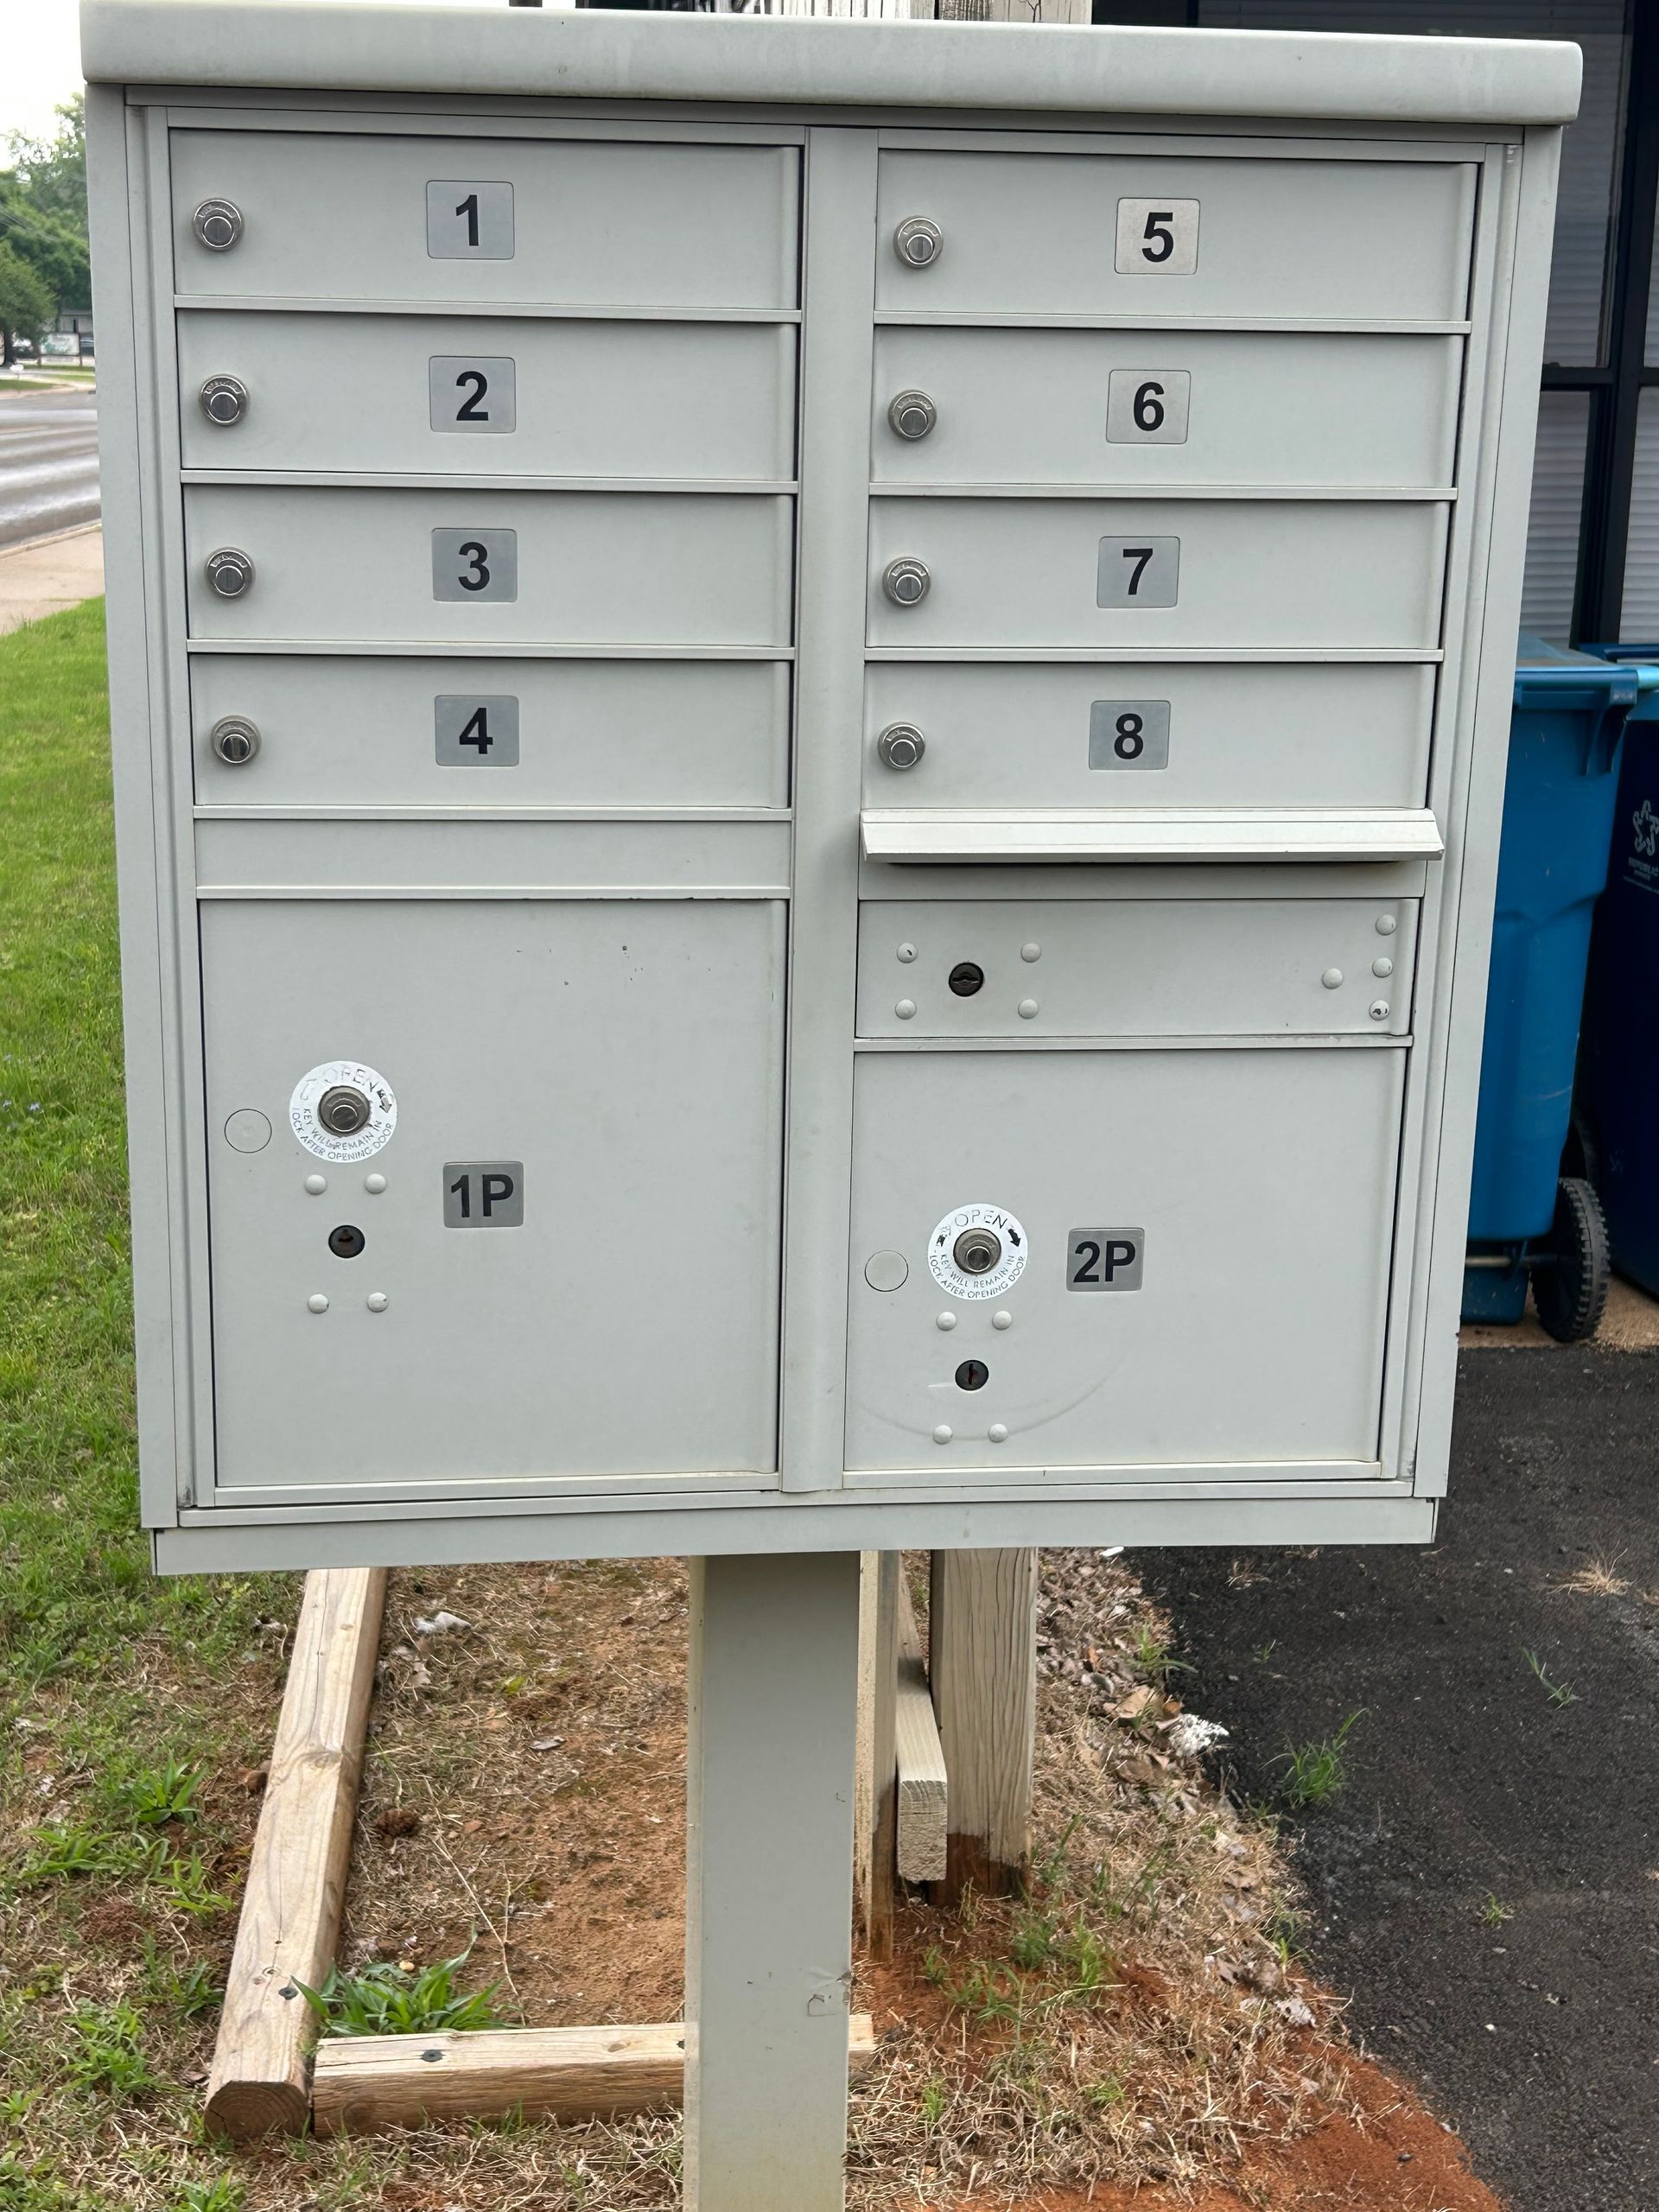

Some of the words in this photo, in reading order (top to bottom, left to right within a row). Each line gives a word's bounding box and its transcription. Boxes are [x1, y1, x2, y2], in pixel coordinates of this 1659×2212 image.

[455, 194, 480, 246] 1
[1141, 212, 1174, 263] 5
[455, 371, 489, 422] 2
[1133, 381, 1165, 432] 6
[458, 541, 491, 592] 3
[1122, 548, 1154, 595] 7
[459, 707, 493, 755] 4
[1114, 713, 1144, 760] 8
[300, 1135, 326, 1156] AFTER
[327, 1147, 372, 1161] OPENING
[373, 1122, 394, 1149] DOOR
[303, 1108, 313, 1125] KEY
[311, 1128, 334, 1149] WILL
[334, 1132, 374, 1151] REMAIN
[372, 1120, 382, 1132] IN
[450, 1173, 514, 1218] 1P
[954, 1209, 1007, 1229] OPEN
[930, 1255, 944, 1279] LOCK
[940, 1280, 965, 1297] AFTER
[967, 1281, 1008, 1299] OPENING
[1008, 1255, 1026, 1282] DOOR
[940, 1254, 952, 1270] KEY
[950, 1271, 969, 1287] WILL
[973, 1268, 1009, 1288] REMAIN
[1006, 1255, 1014, 1265] IN
[1072, 1240, 1136, 1283] 2P
